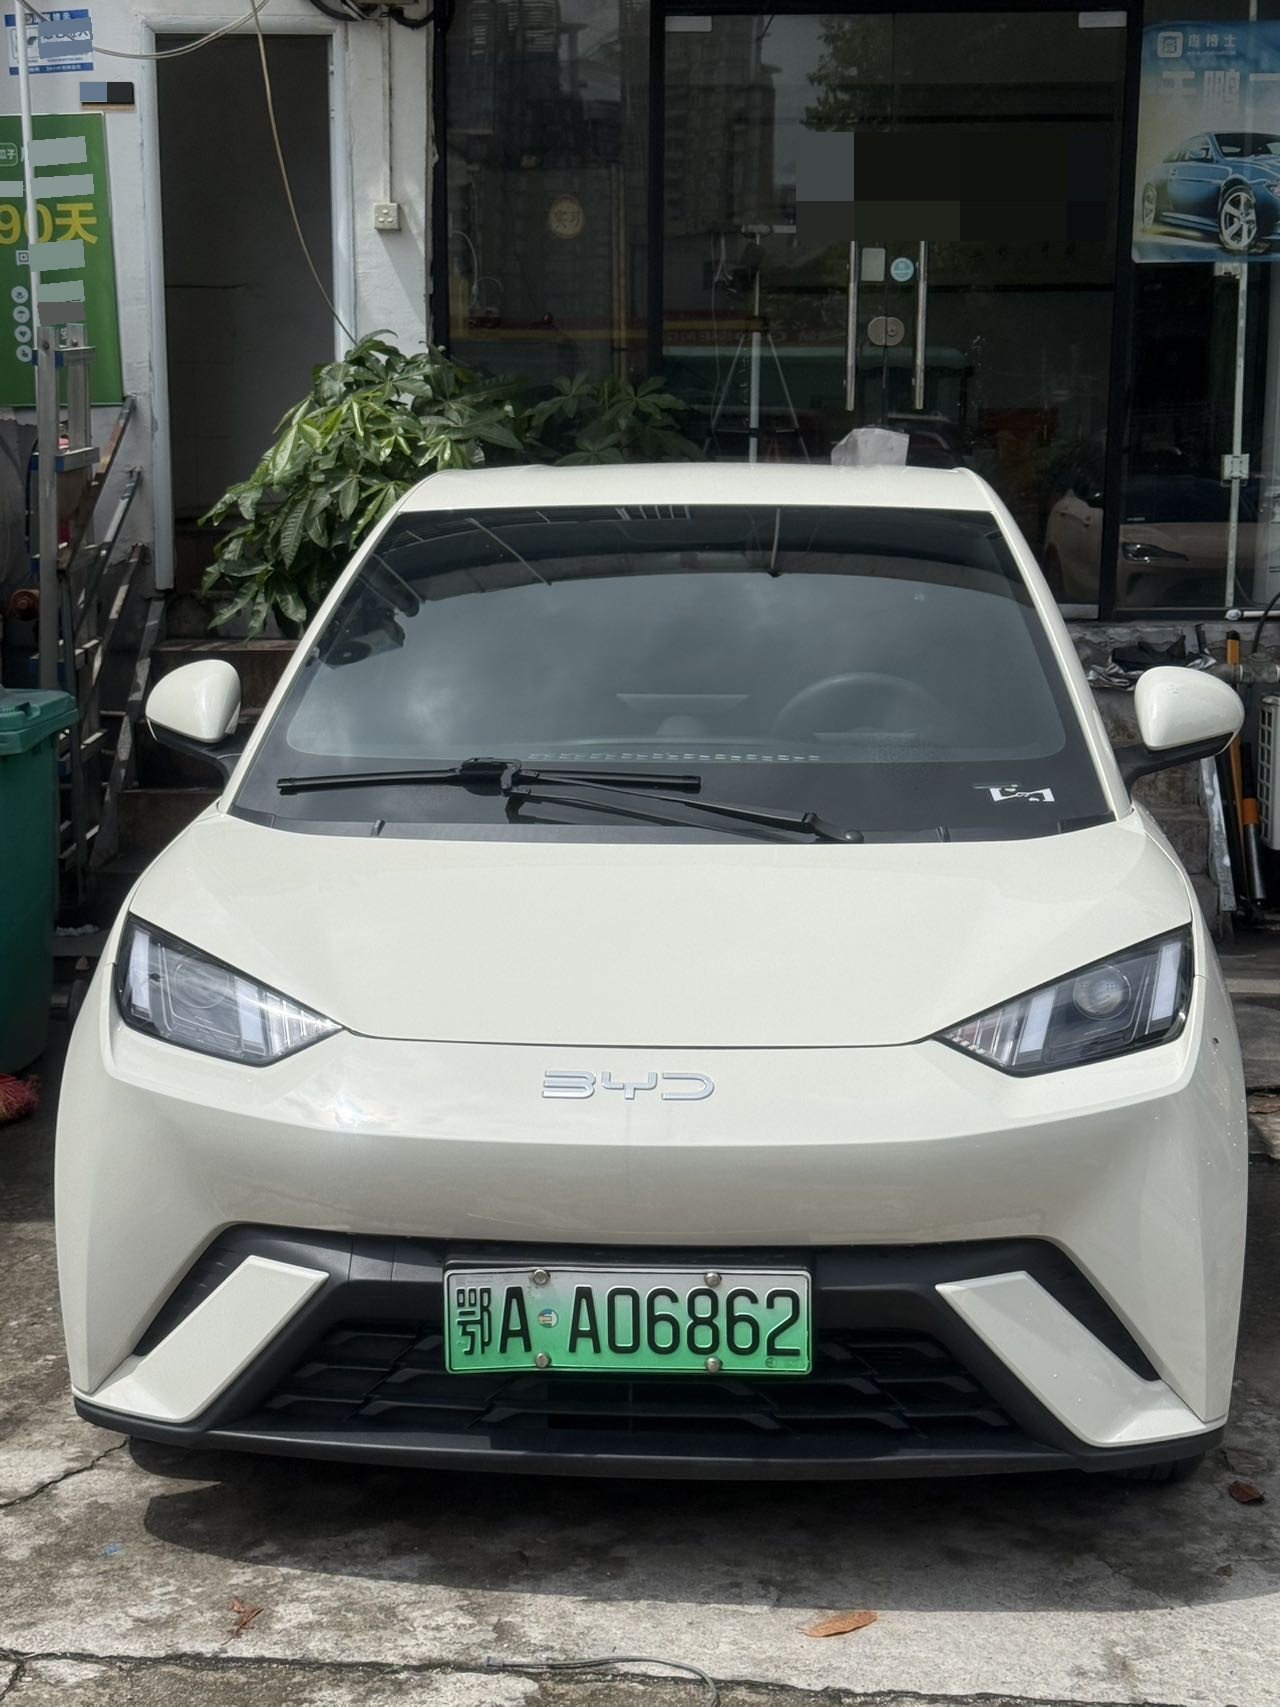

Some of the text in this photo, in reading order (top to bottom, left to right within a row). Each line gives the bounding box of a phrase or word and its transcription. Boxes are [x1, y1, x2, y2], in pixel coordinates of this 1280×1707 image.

[0, 202, 97, 245] 90天
[542, 1070, 715, 1101] BYD
[456, 1286, 800, 1355] 鄂A A06862
